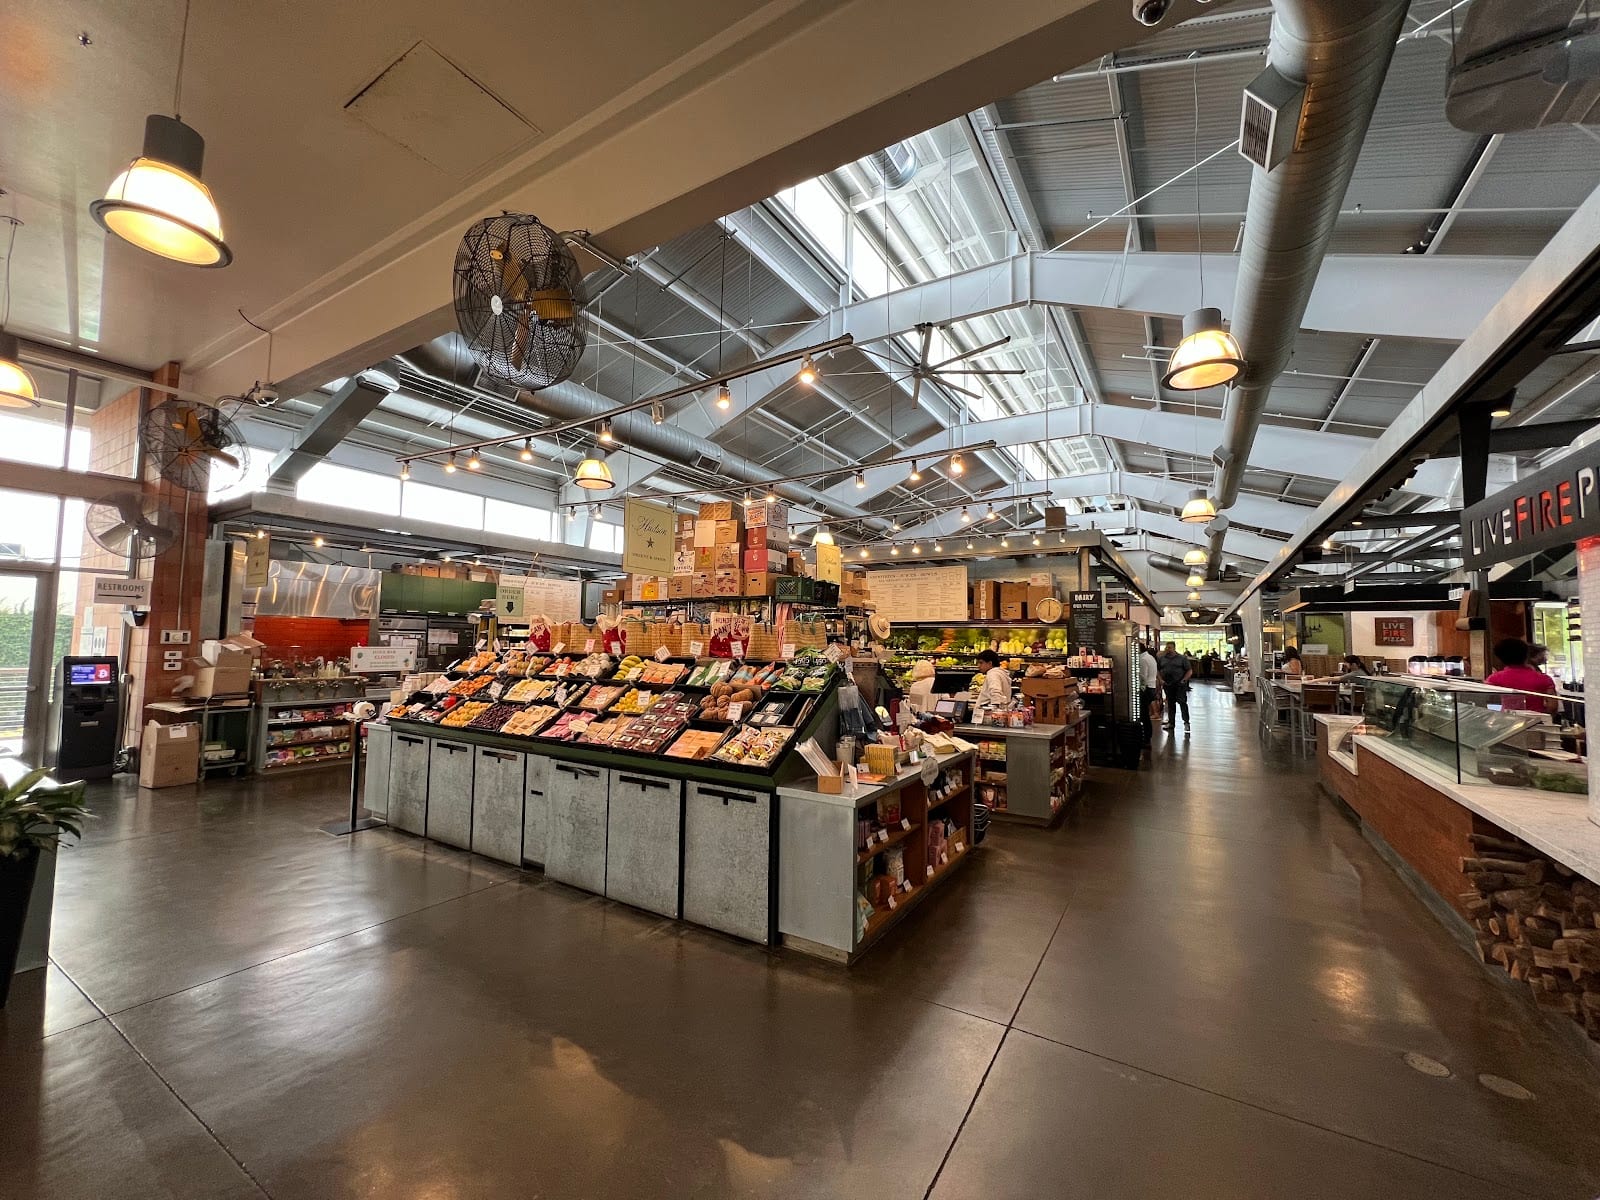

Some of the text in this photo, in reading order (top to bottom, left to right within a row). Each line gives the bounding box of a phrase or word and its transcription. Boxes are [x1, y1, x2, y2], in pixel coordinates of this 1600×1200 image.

[1471, 466, 1600, 556] LIVE FIRE P
[631, 515, 668, 536] Hudson
[97, 582, 145, 593] RESTROOMS
[1382, 622, 1406, 630] LIVE
